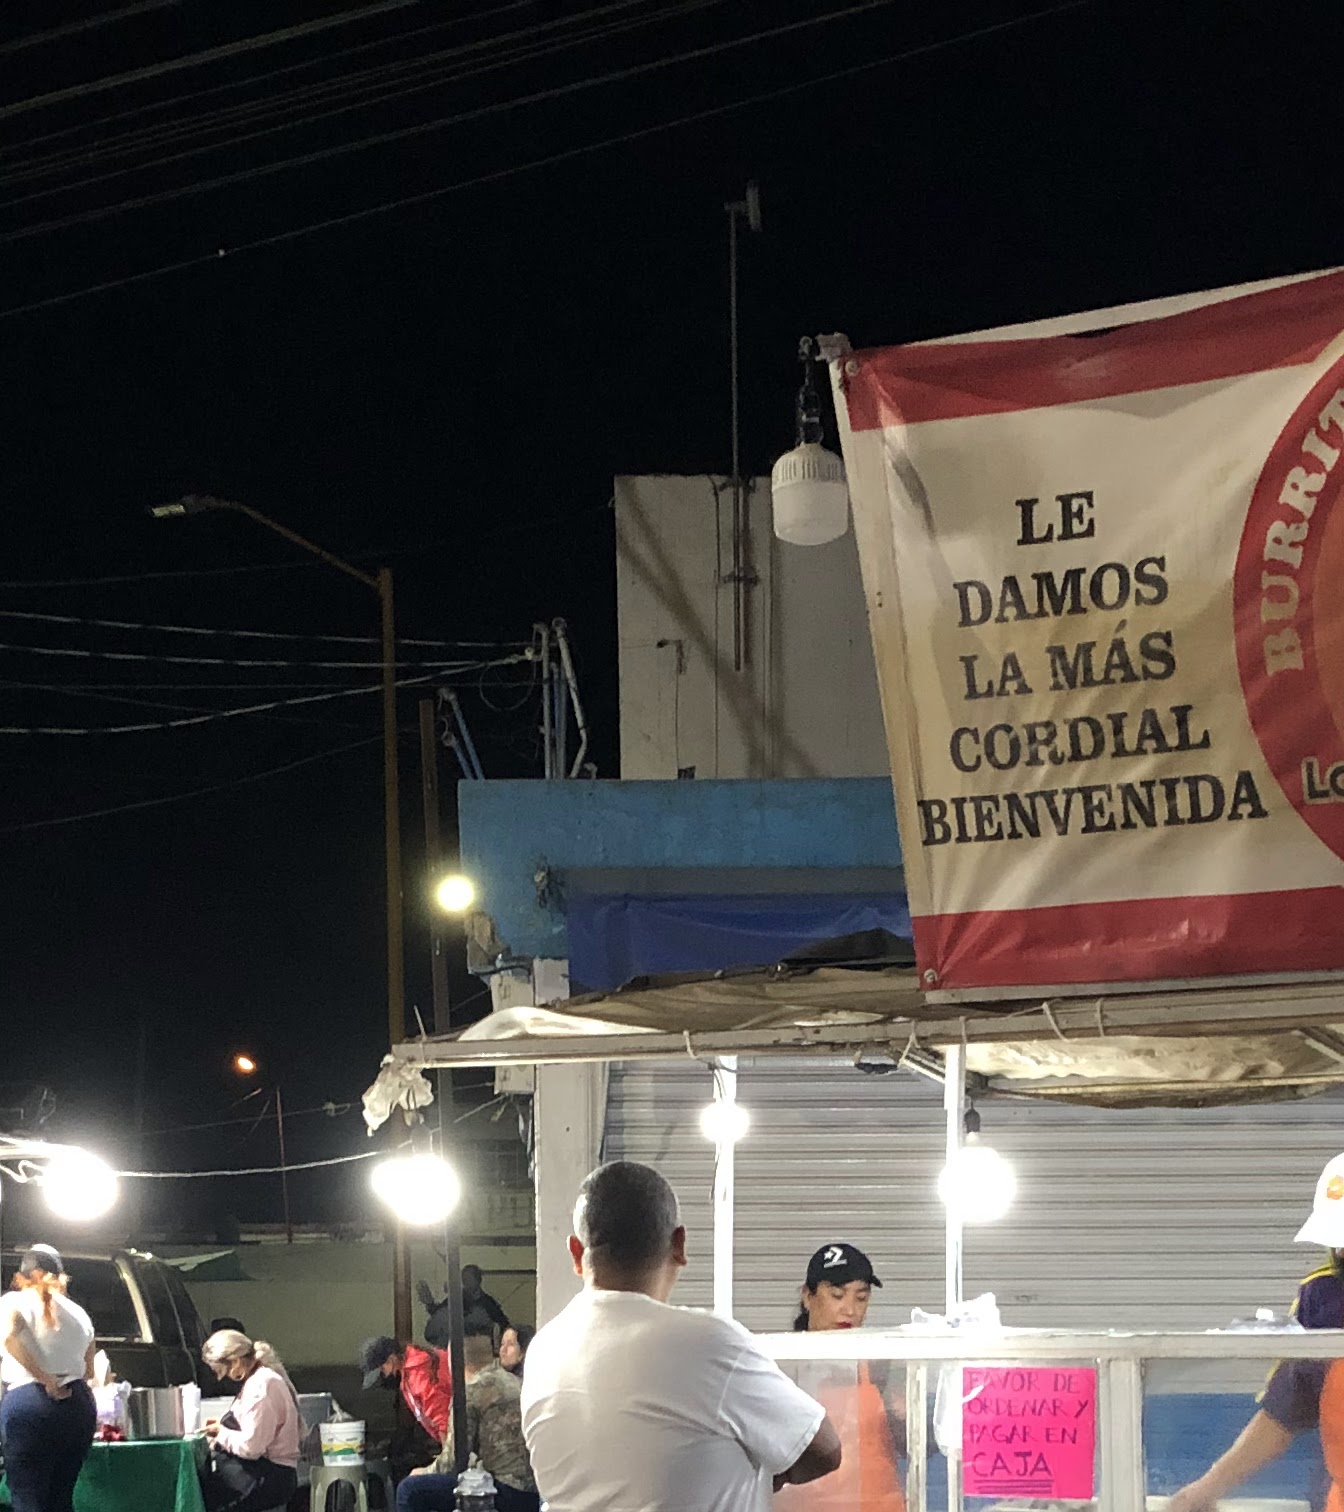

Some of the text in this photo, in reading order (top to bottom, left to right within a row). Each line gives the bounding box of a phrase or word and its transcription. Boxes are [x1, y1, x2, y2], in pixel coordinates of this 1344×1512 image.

[1015, 490, 1095, 546] LE
[953, 555, 1169, 629] DAMOS
[959, 619, 1178, 700] LA MÁS
[949, 704, 1211, 774] CORDIAL
[917, 769, 1269, 847] BIENVENIDA
[967, 1397, 1068, 1418] ORDENAR
[968, 1370, 1081, 1393] FAVOR DE
[970, 1424, 1077, 1444] PAGAR EN
[972, 1451, 1053, 1477] CAJA
